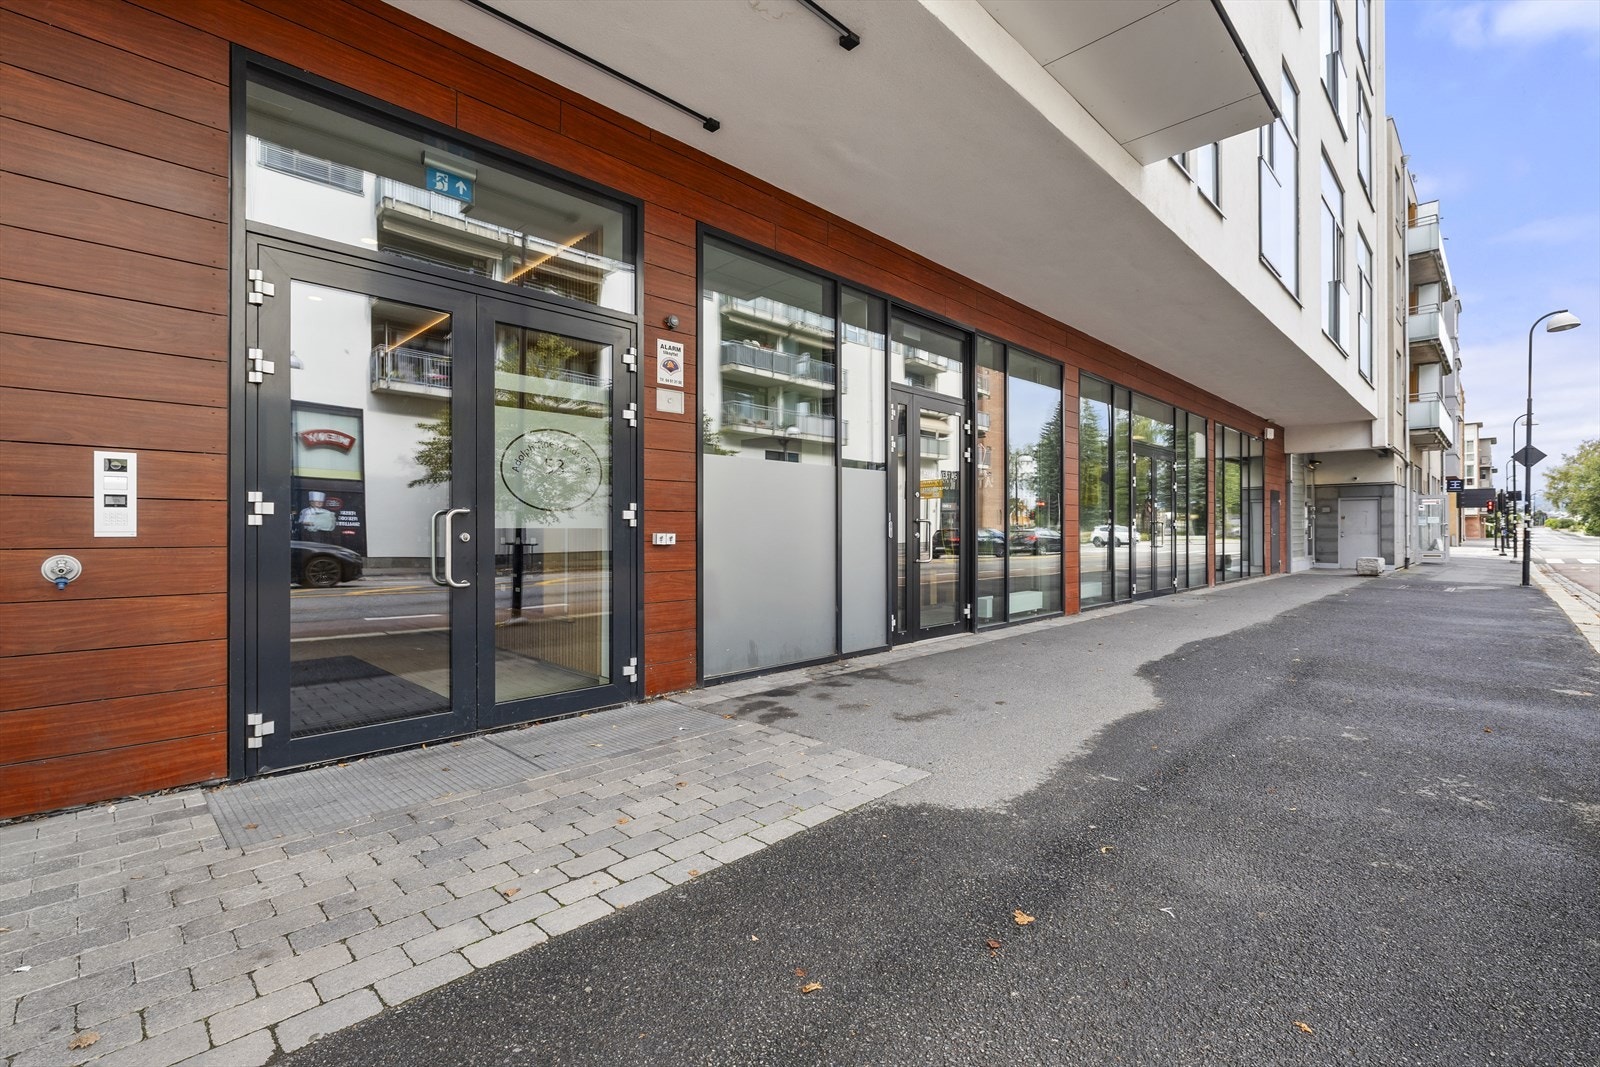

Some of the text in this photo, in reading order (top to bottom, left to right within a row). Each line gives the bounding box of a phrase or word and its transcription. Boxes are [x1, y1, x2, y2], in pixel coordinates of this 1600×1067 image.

[660, 343, 681, 352] ALARM
[511, 444, 536, 474] Adolph
[535, 440, 580, 459] Tideands
